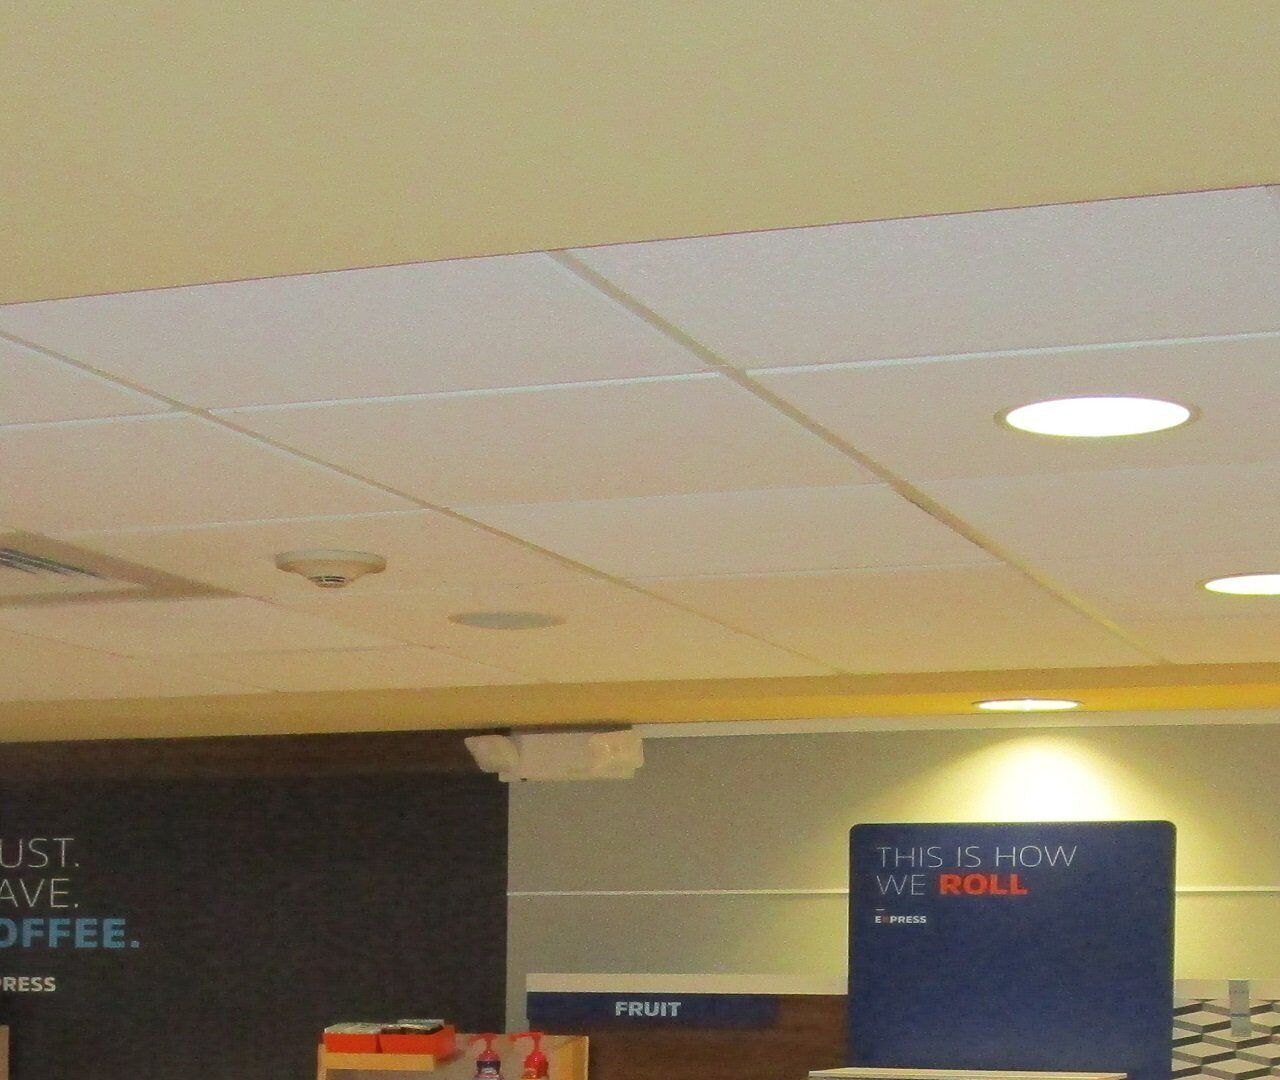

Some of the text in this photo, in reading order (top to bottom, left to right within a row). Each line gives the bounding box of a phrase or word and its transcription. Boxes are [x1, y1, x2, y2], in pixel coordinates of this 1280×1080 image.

[876, 845, 1078, 868] THIS IS HOW
[876, 873, 1028, 896] WE ROLL
[615, 1001, 682, 1017] FRUIT
